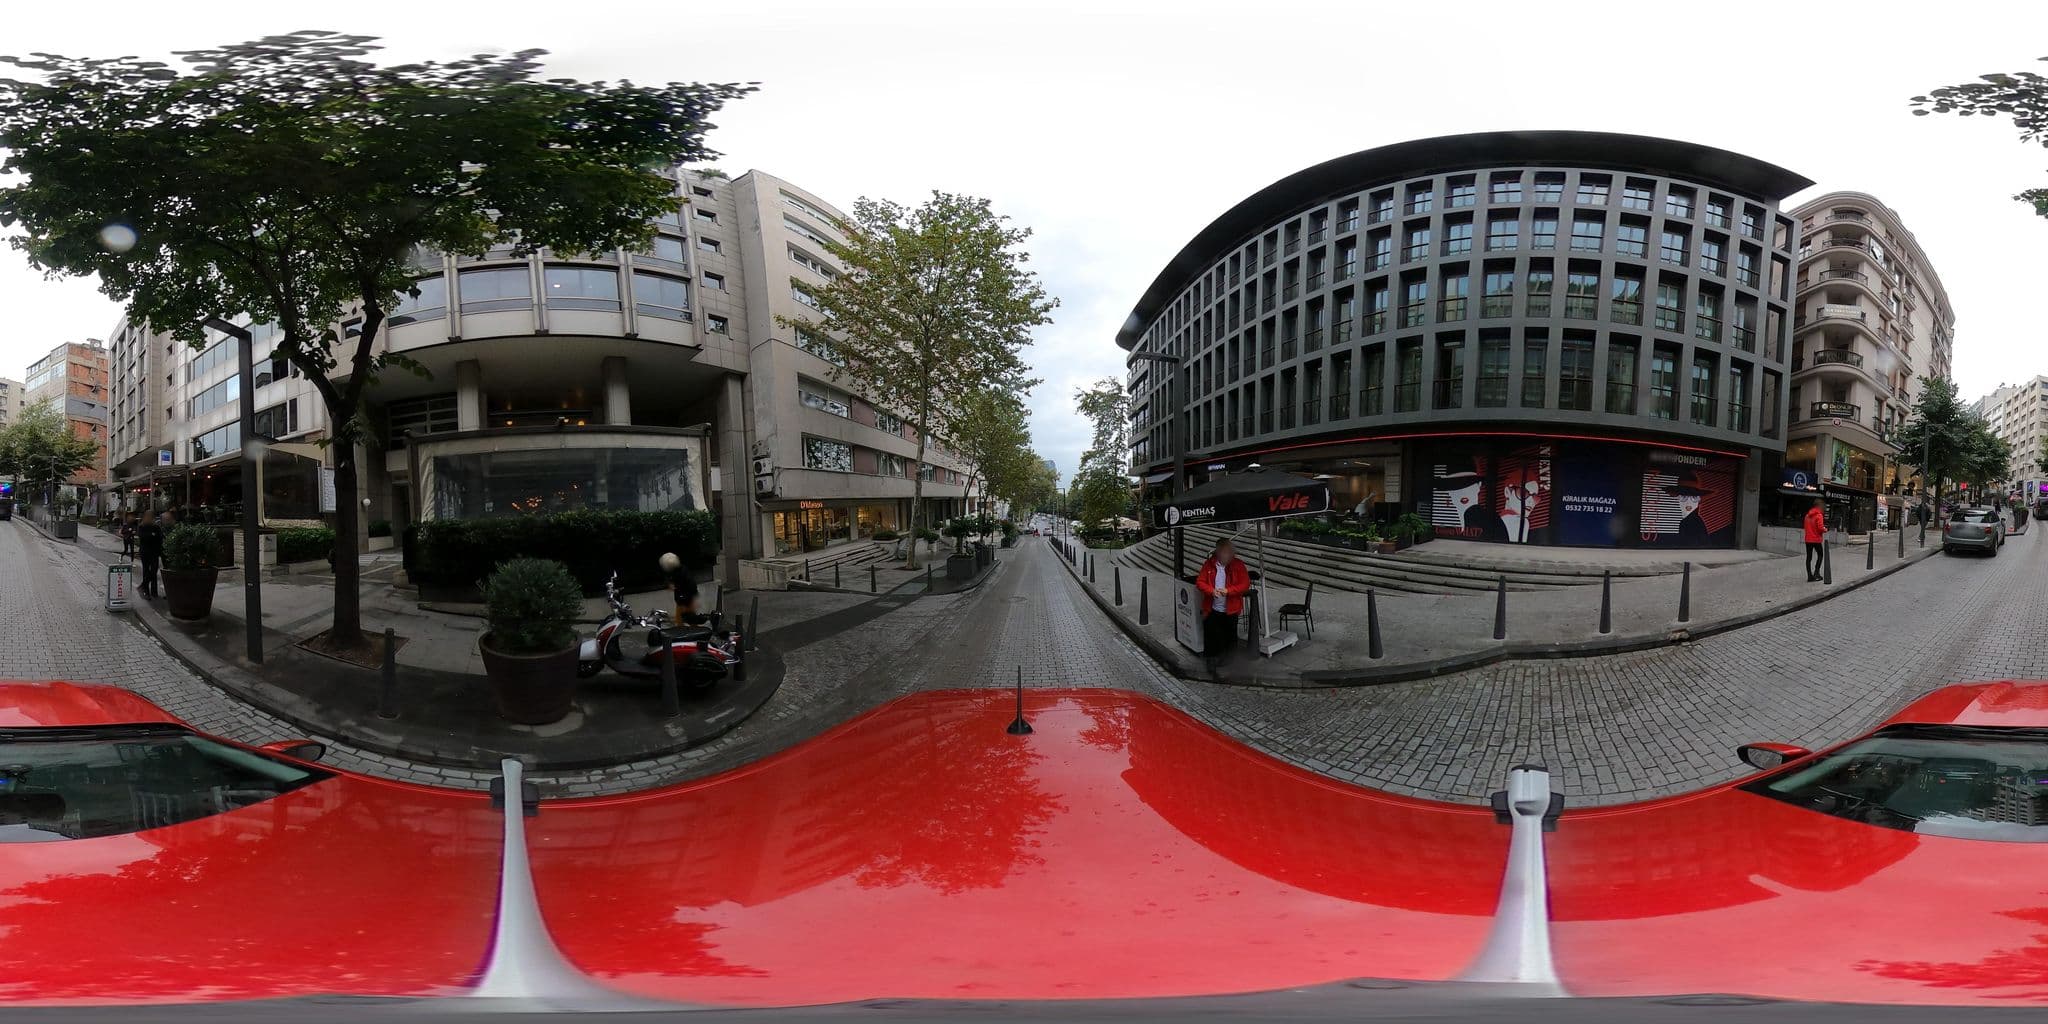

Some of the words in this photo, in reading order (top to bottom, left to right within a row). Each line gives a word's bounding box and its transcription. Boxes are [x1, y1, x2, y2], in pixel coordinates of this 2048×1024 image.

[1268, 493, 1311, 512] Vale
[1562, 494, 1588, 503] KİRALIK
[1588, 496, 1617, 505] MAĞAZA
[1182, 506, 1216, 518] KENTHAŞ
[1565, 504, 1581, 512] 0532
